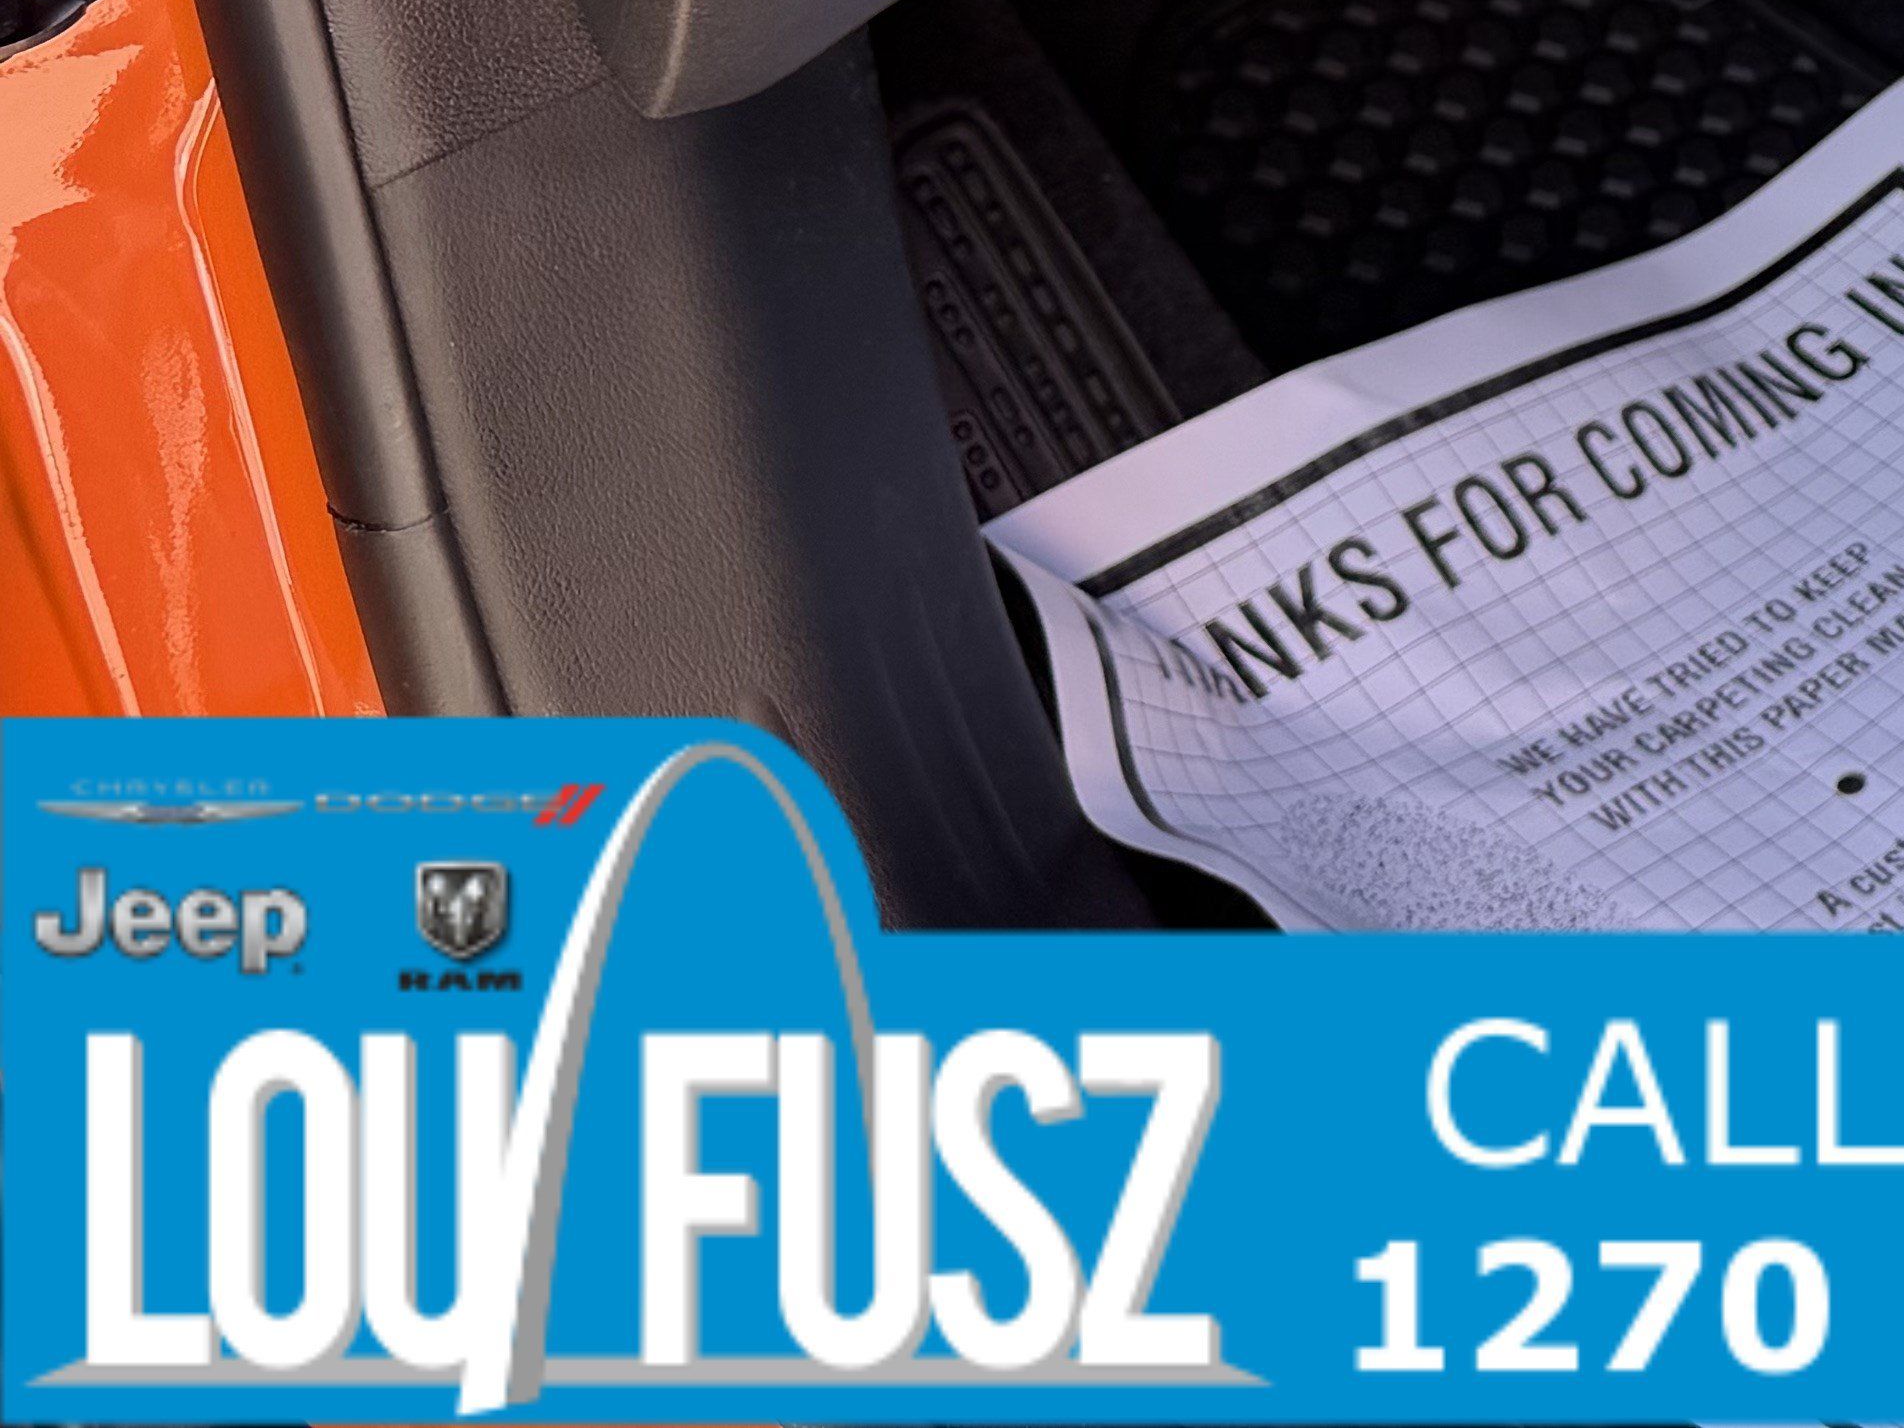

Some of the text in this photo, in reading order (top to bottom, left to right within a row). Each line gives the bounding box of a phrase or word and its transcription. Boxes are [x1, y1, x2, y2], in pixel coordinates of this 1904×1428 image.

[1402, 450, 1588, 591] FOR
[1574, 320, 1872, 501] COMING
[1499, 541, 1873, 778] WE HAVE TRIED TO KEEP
[1532, 746, 1640, 809] YOUR
[1634, 635, 1816, 757] CARPETING
[1587, 769, 1689, 833] WITH
[1684, 724, 1767, 783] THIS
[1760, 651, 1872, 733] PAPER
[1816, 889, 1852, 918] A
